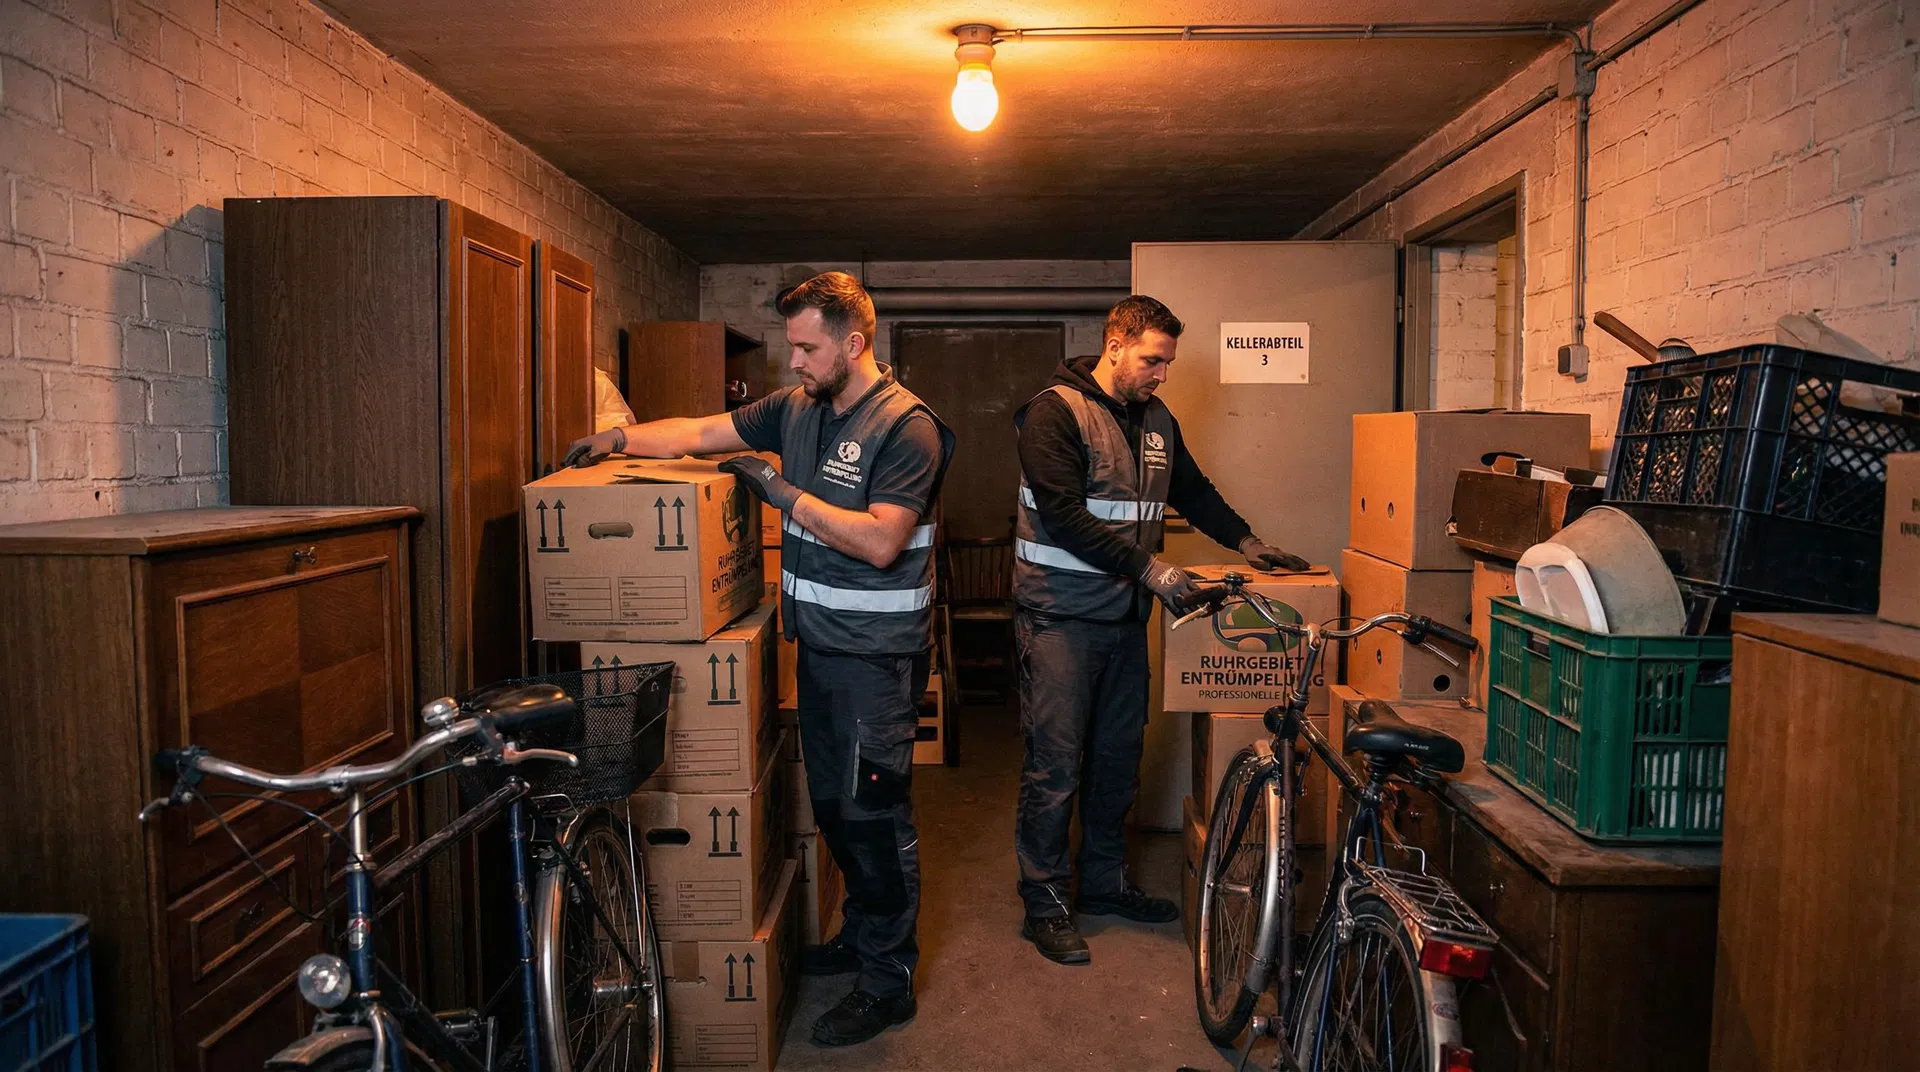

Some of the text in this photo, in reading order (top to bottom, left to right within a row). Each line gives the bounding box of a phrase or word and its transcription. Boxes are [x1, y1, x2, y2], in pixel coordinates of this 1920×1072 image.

[1226, 337, 1304, 349] KELLERABTEIL
[1261, 354, 1268, 366] 3
[1201, 656, 1304, 670] RUHRGEBIET
[1181, 669, 1324, 687] ENTRÜMPELUG
[1199, 690, 1281, 700] PROFESSIONELLE
